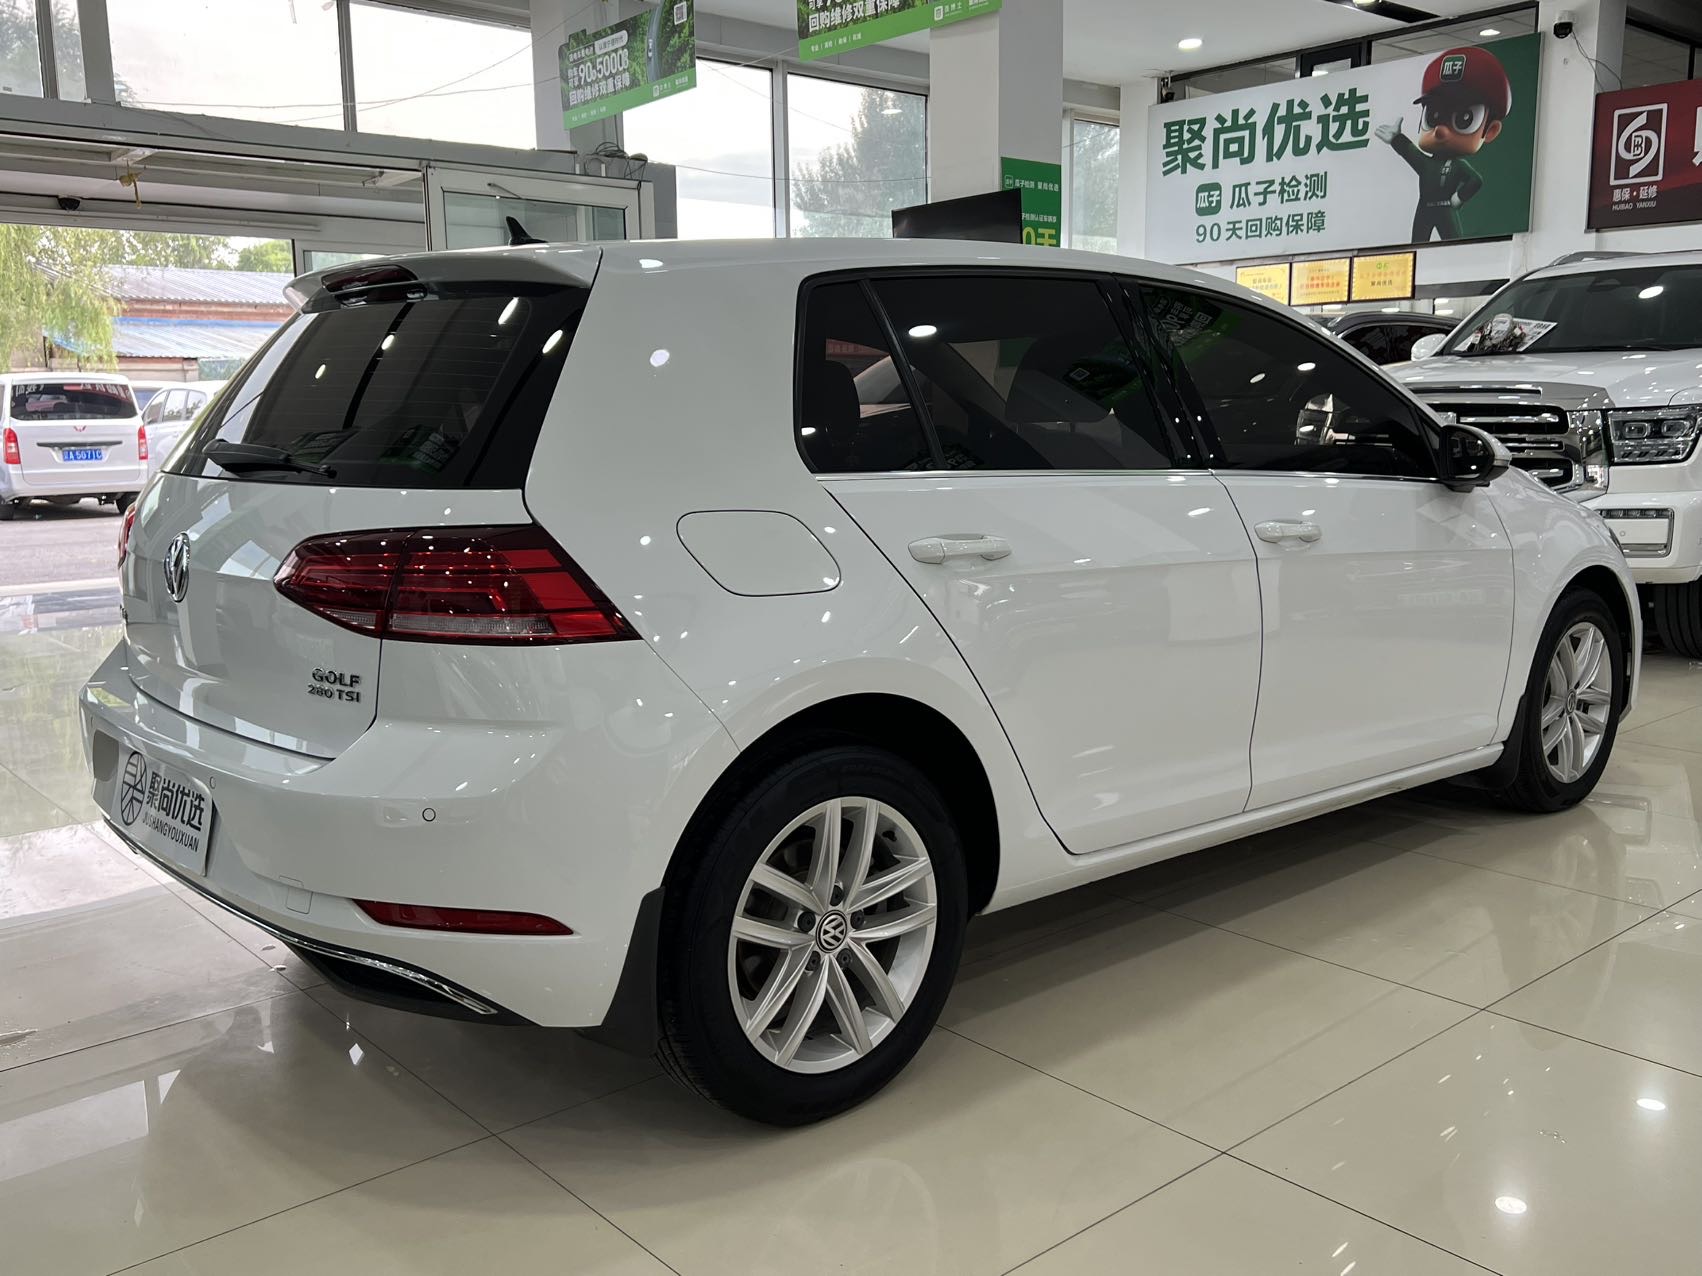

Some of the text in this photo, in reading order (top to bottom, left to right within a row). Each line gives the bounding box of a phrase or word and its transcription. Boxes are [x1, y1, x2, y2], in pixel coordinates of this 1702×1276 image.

[1444, 61, 1463, 75] 瓜子
[1162, 88, 1370, 176] 聚尚优选
[1197, 171, 1328, 210] 瓜子 瓜子检测
[1612, 200, 1657, 211] HUIBAO YANXIU
[1195, 210, 1326, 243] 90天回购保障
[312, 668, 360, 688] GOLF
[307, 684, 360, 702] 280 TSI
[146, 771, 205, 832] 聚尚优选
